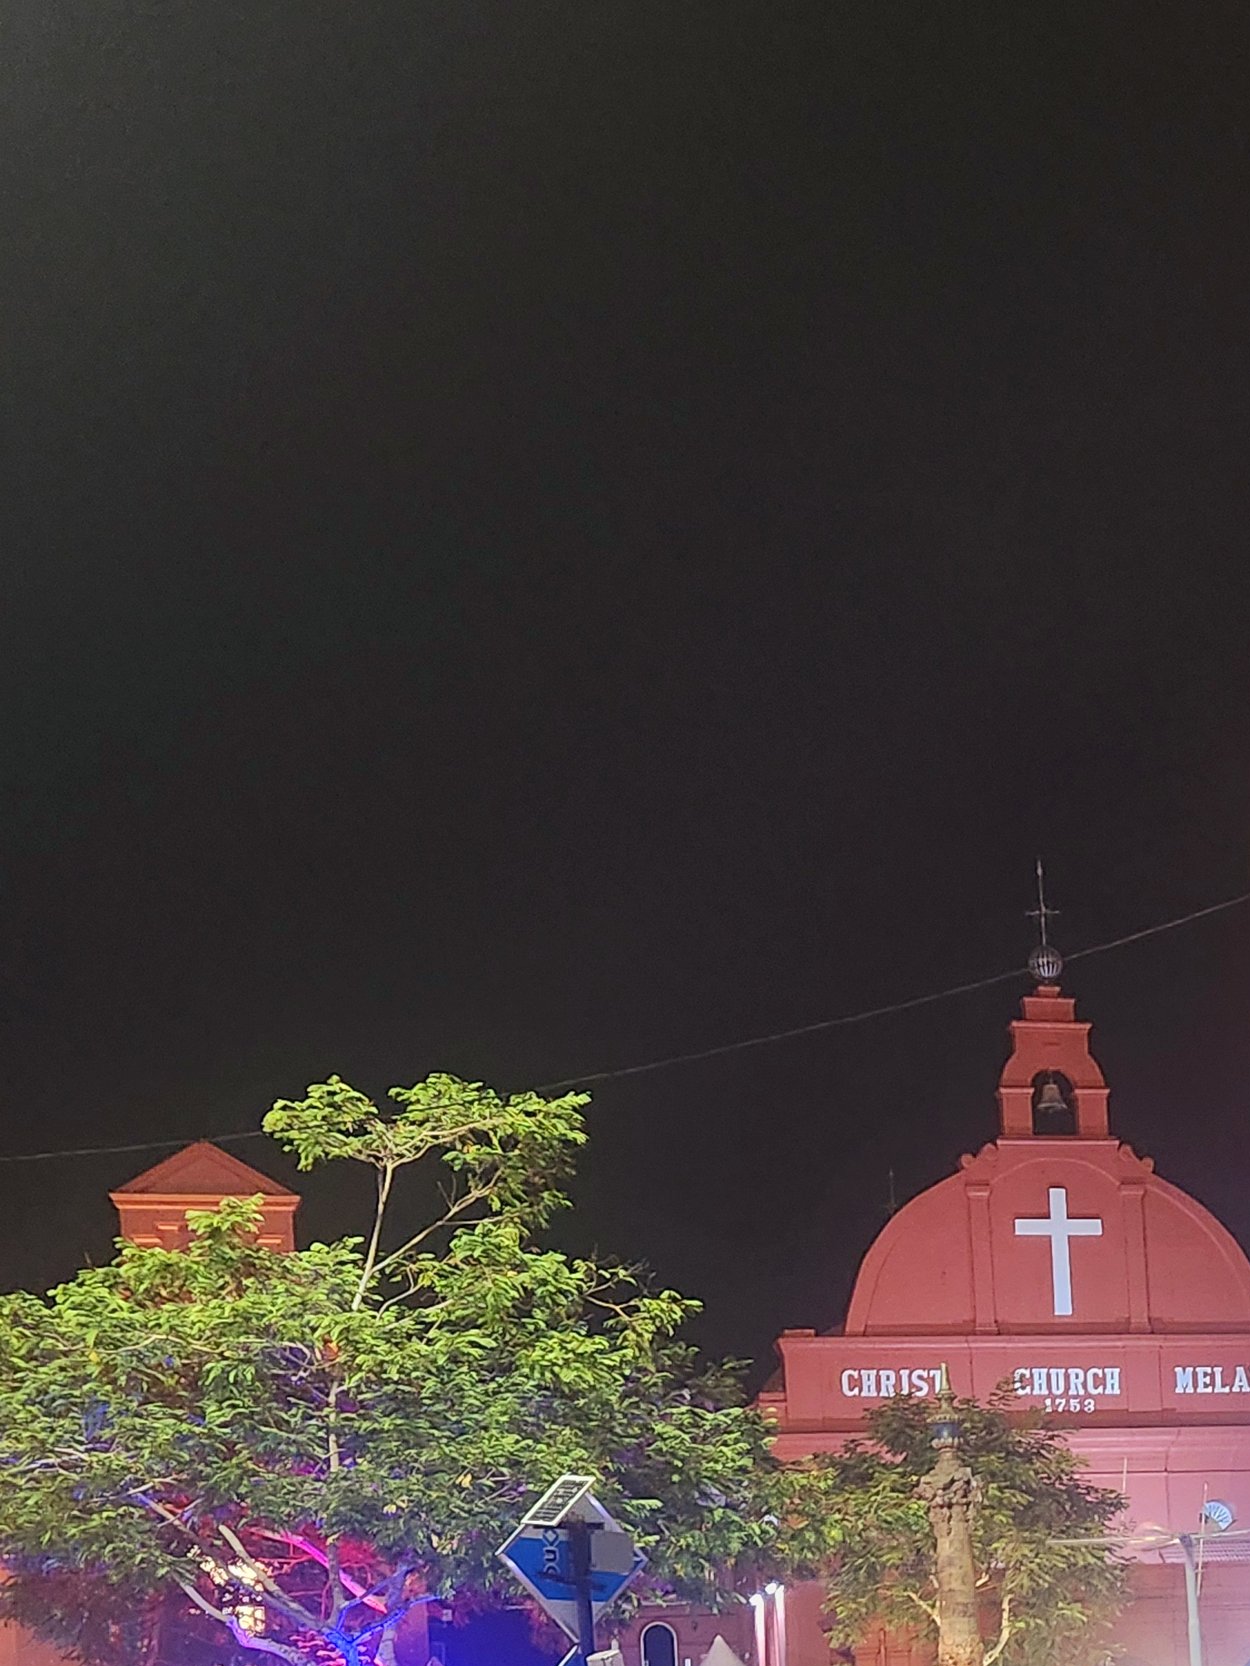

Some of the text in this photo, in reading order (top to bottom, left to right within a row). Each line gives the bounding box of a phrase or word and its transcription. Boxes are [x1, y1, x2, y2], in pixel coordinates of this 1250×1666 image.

[841, 1368, 942, 1397] CHRIST
[1014, 1367, 1121, 1395] CHURCH
[1045, 1398, 1096, 1413] 1753
